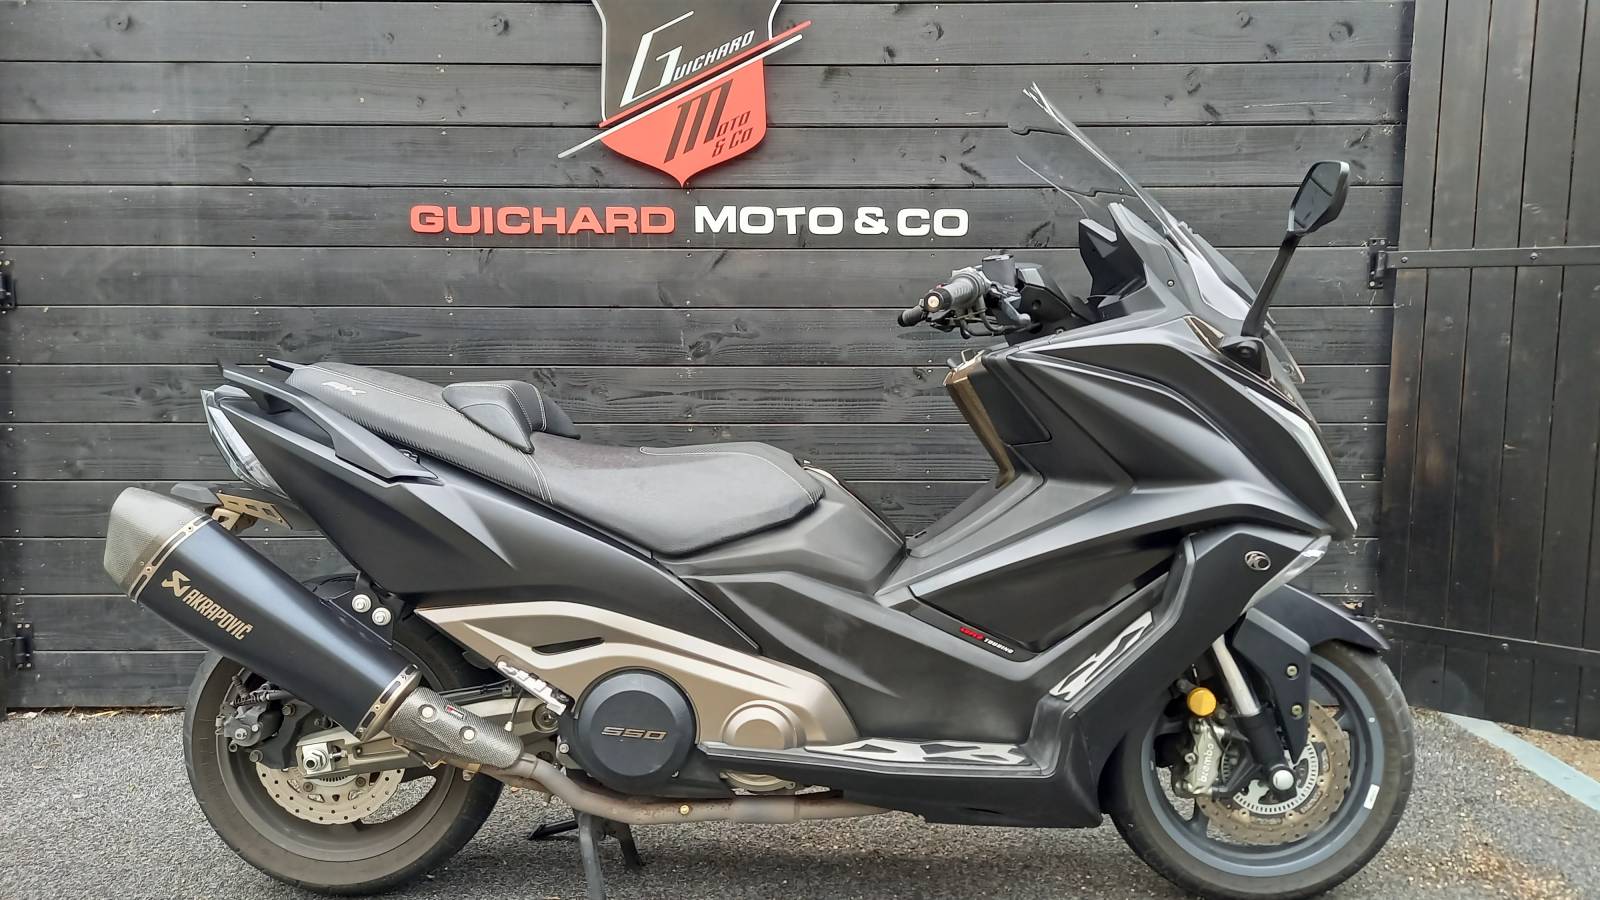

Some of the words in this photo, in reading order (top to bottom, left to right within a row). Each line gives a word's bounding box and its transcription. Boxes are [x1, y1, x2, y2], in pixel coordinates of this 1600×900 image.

[620, 11, 755, 107] GUICHARD
[712, 139, 725, 158] &
[410, 205, 675, 234] GUICHARD
[694, 205, 843, 234] MOTO
[854, 206, 889, 234] &
[897, 208, 969, 236] CO
[1200, 743, 1215, 783] brembo
